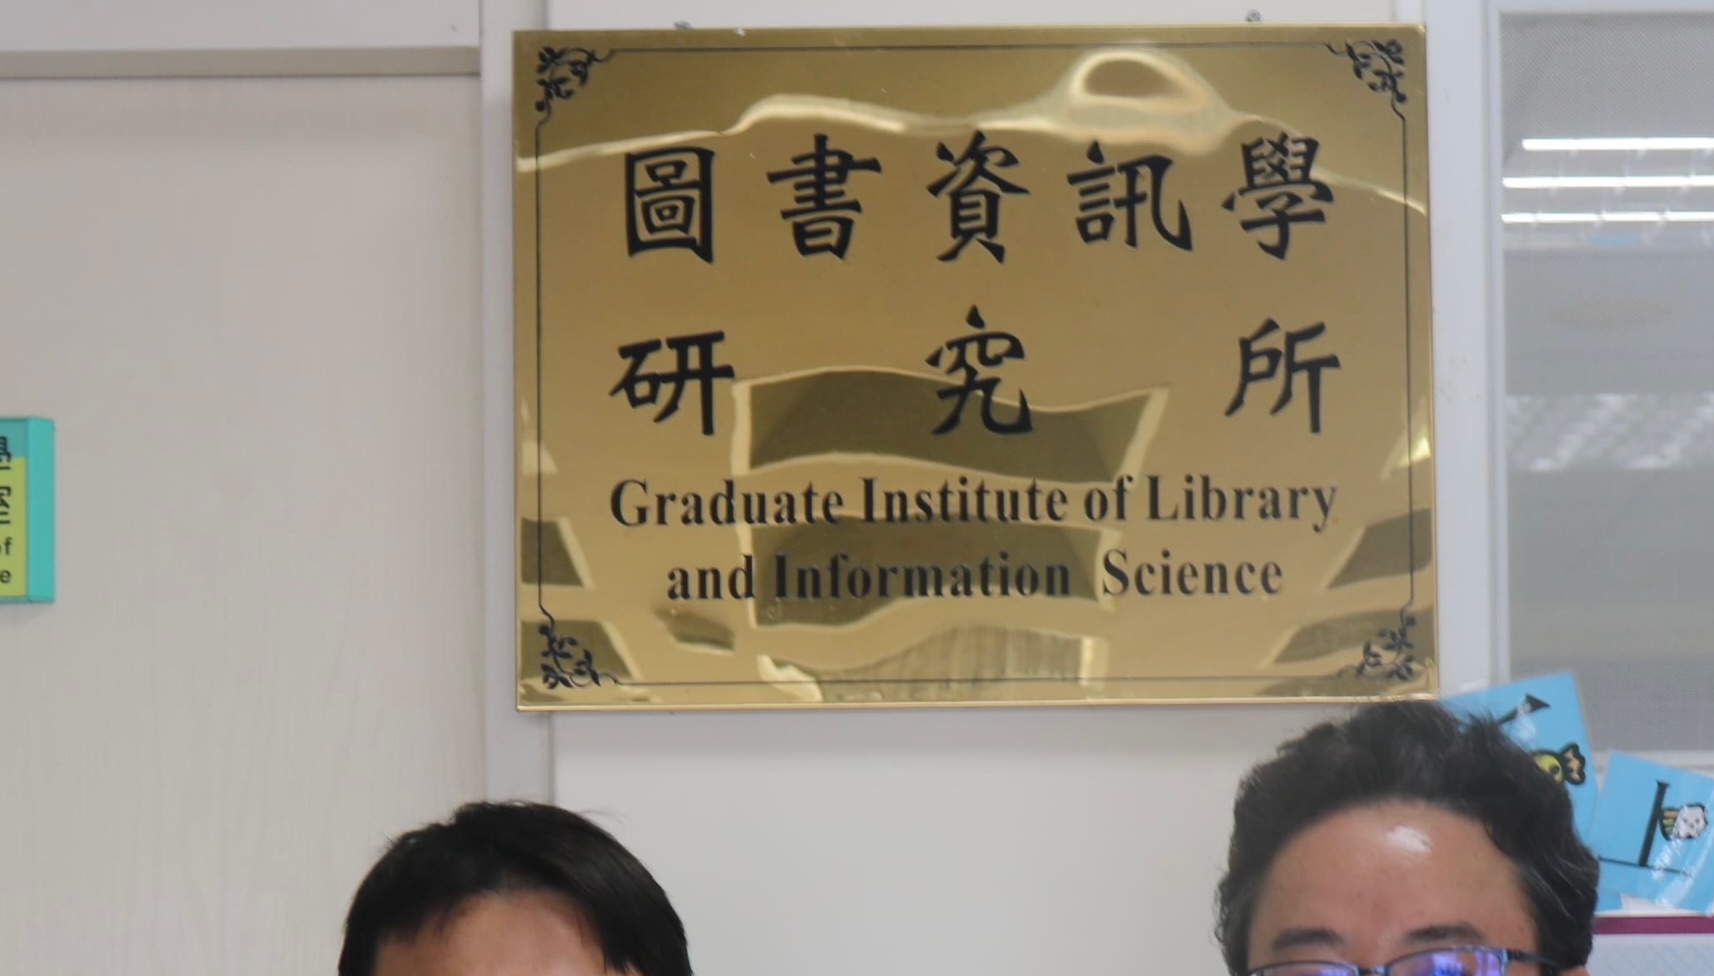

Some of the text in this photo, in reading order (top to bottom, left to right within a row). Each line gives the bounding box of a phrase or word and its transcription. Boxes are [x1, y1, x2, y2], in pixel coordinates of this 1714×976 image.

[624, 130, 1334, 264] 圖書資訊學
[609, 305, 1341, 436] 研究所
[609, 473, 1339, 533] Graduate Institute of Library
[666, 549, 1283, 601] and Information Science
